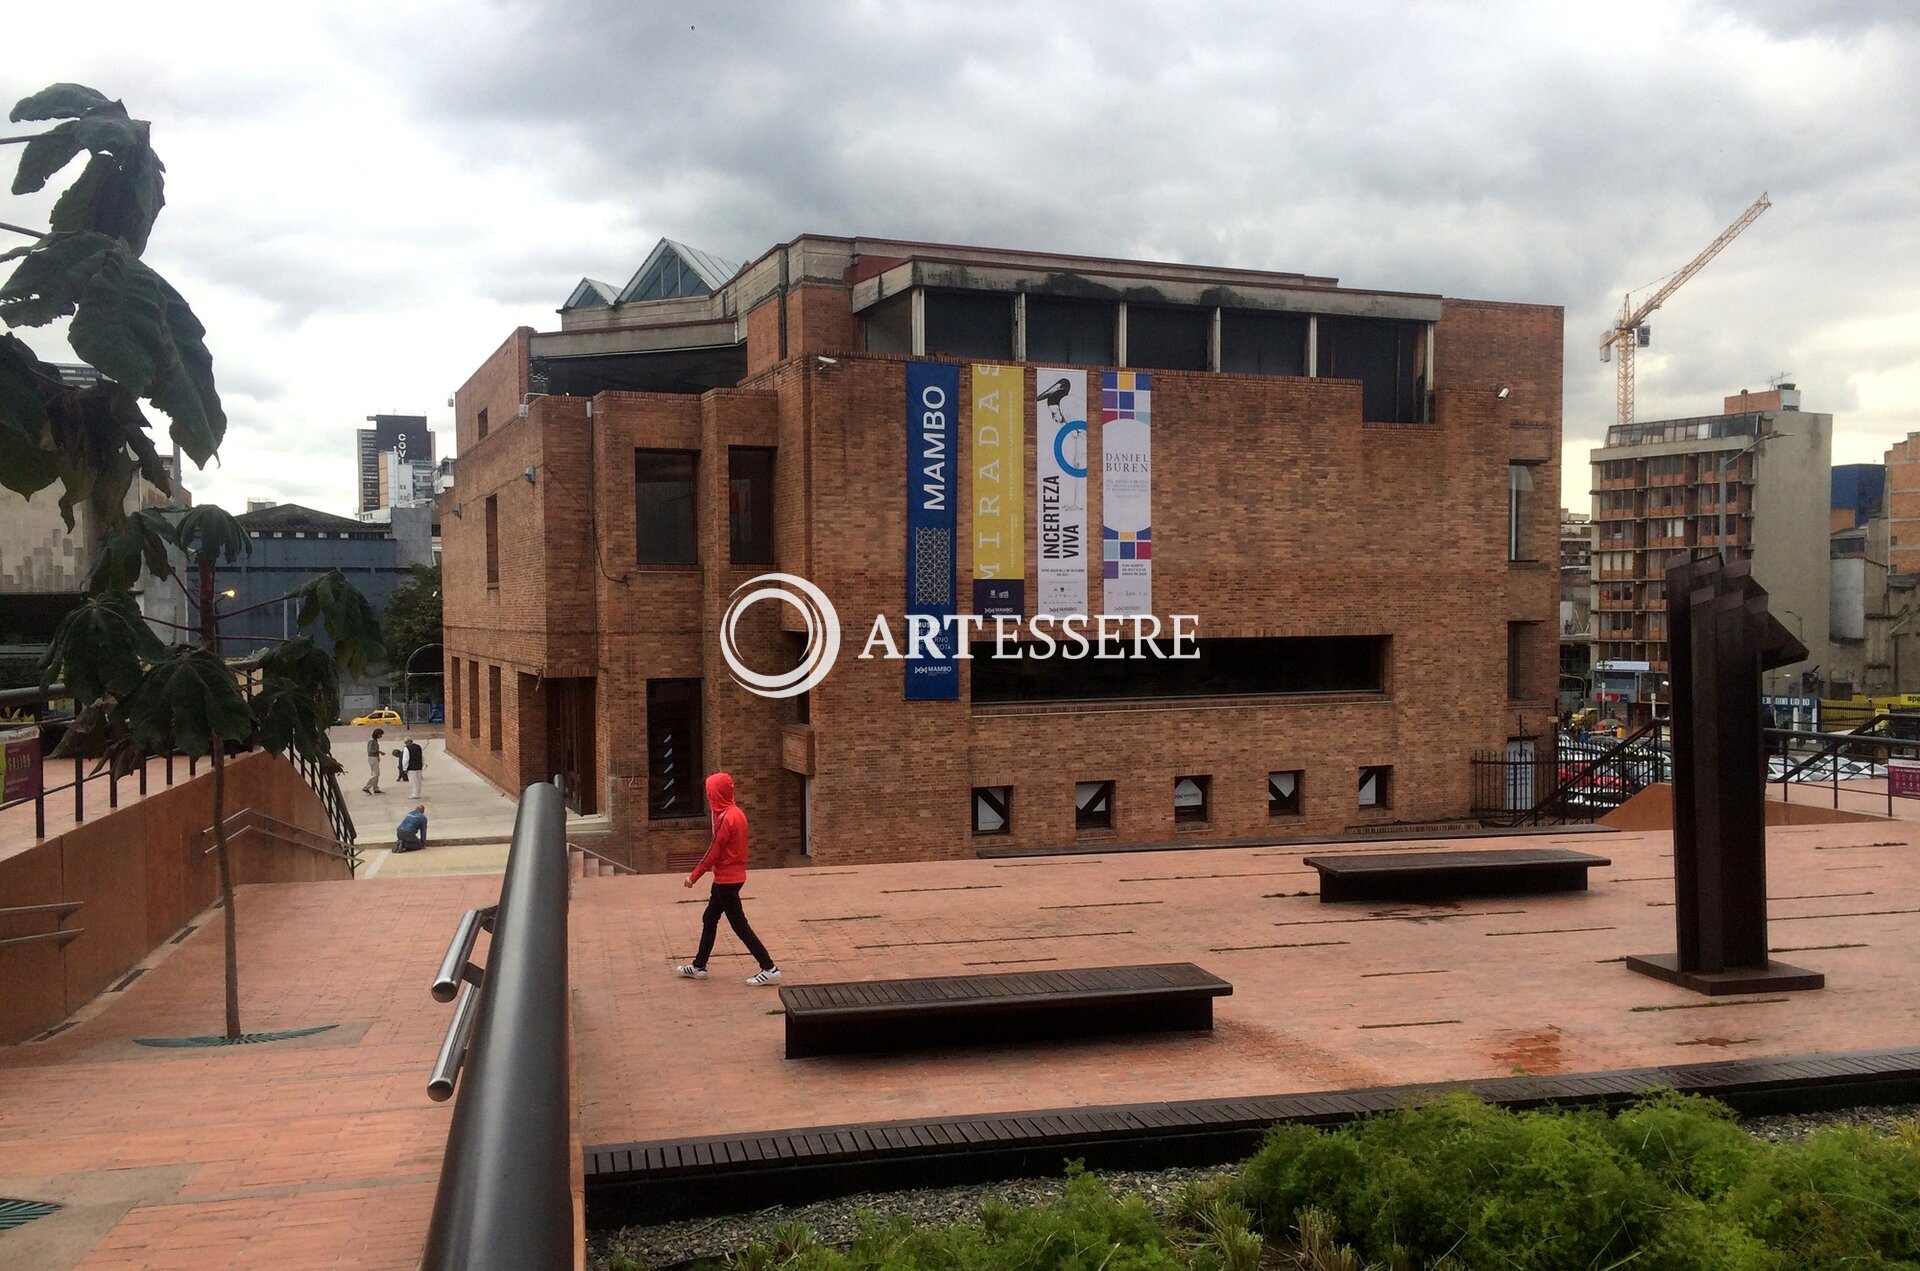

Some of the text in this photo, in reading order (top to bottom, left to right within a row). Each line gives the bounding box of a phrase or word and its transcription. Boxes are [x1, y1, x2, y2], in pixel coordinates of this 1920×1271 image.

[922, 385, 946, 511] MAMBO
[1105, 453, 1149, 462] DANIEL
[1105, 462, 1148, 472] BUREN
[1043, 475, 1060, 559] INCERTEZA
[1062, 524, 1079, 559] VIVA
